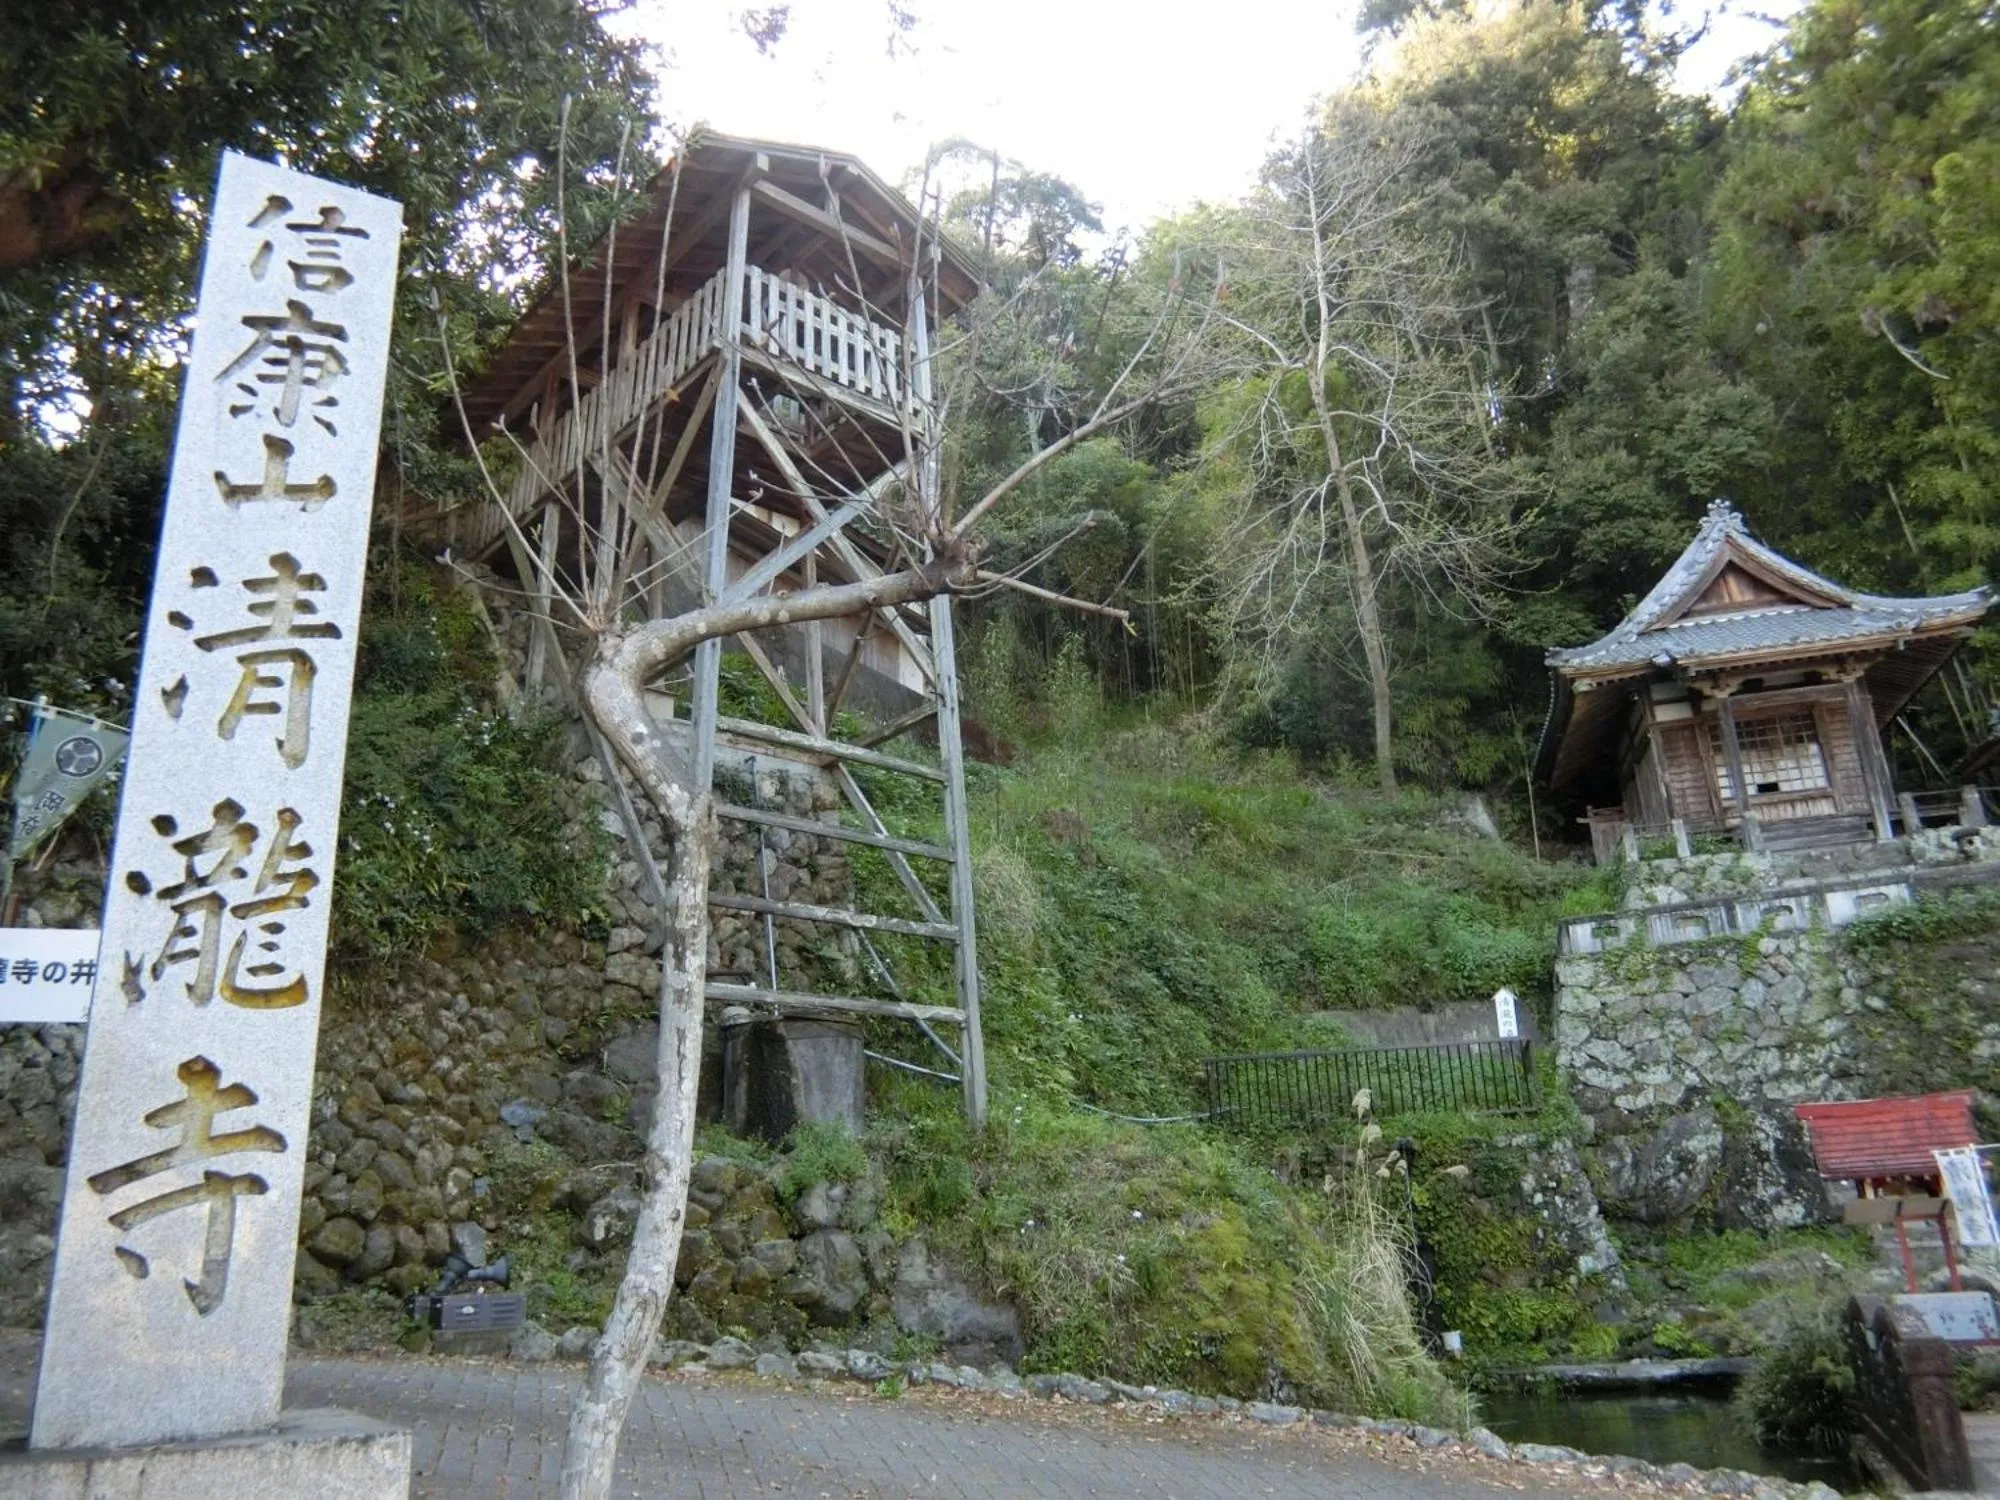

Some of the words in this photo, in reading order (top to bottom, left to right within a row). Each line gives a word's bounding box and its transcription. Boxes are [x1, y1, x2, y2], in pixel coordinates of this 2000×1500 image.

[87, 194, 370, 1317] 信康山清瀧寺
